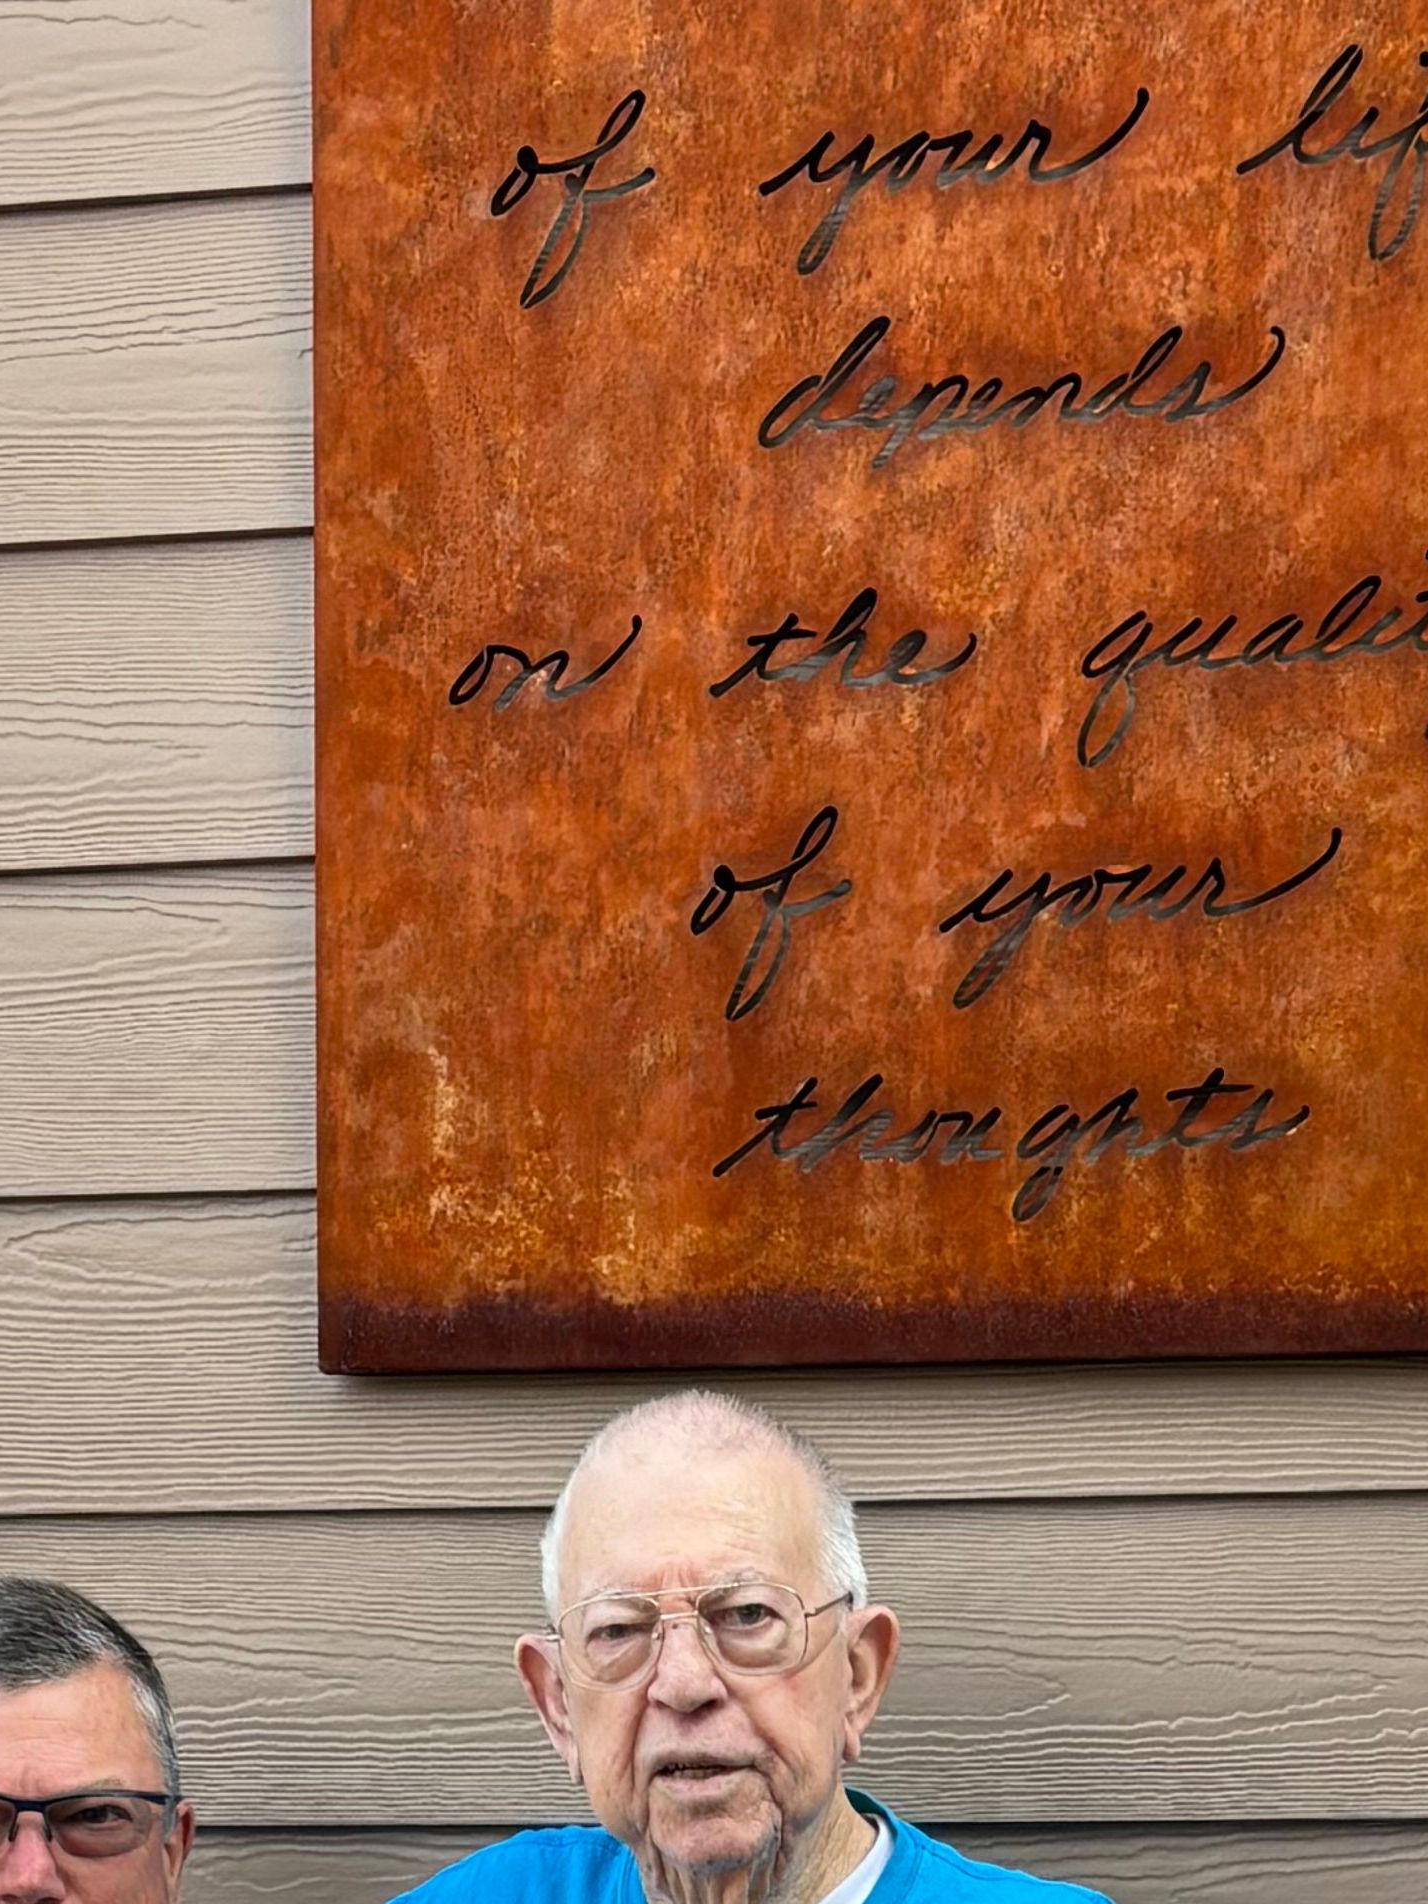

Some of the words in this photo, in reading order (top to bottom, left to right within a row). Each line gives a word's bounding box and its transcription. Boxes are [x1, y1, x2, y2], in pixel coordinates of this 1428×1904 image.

[488, 88, 656, 308] of
[759, 86, 1149, 271] your
[758, 316, 1286, 467] depends
[449, 615, 643, 712] on
[710, 587, 976, 698] the
[690, 806, 850, 1021] of
[939, 828, 1342, 1009] your
[713, 1067, 1310, 1218] thoughts
